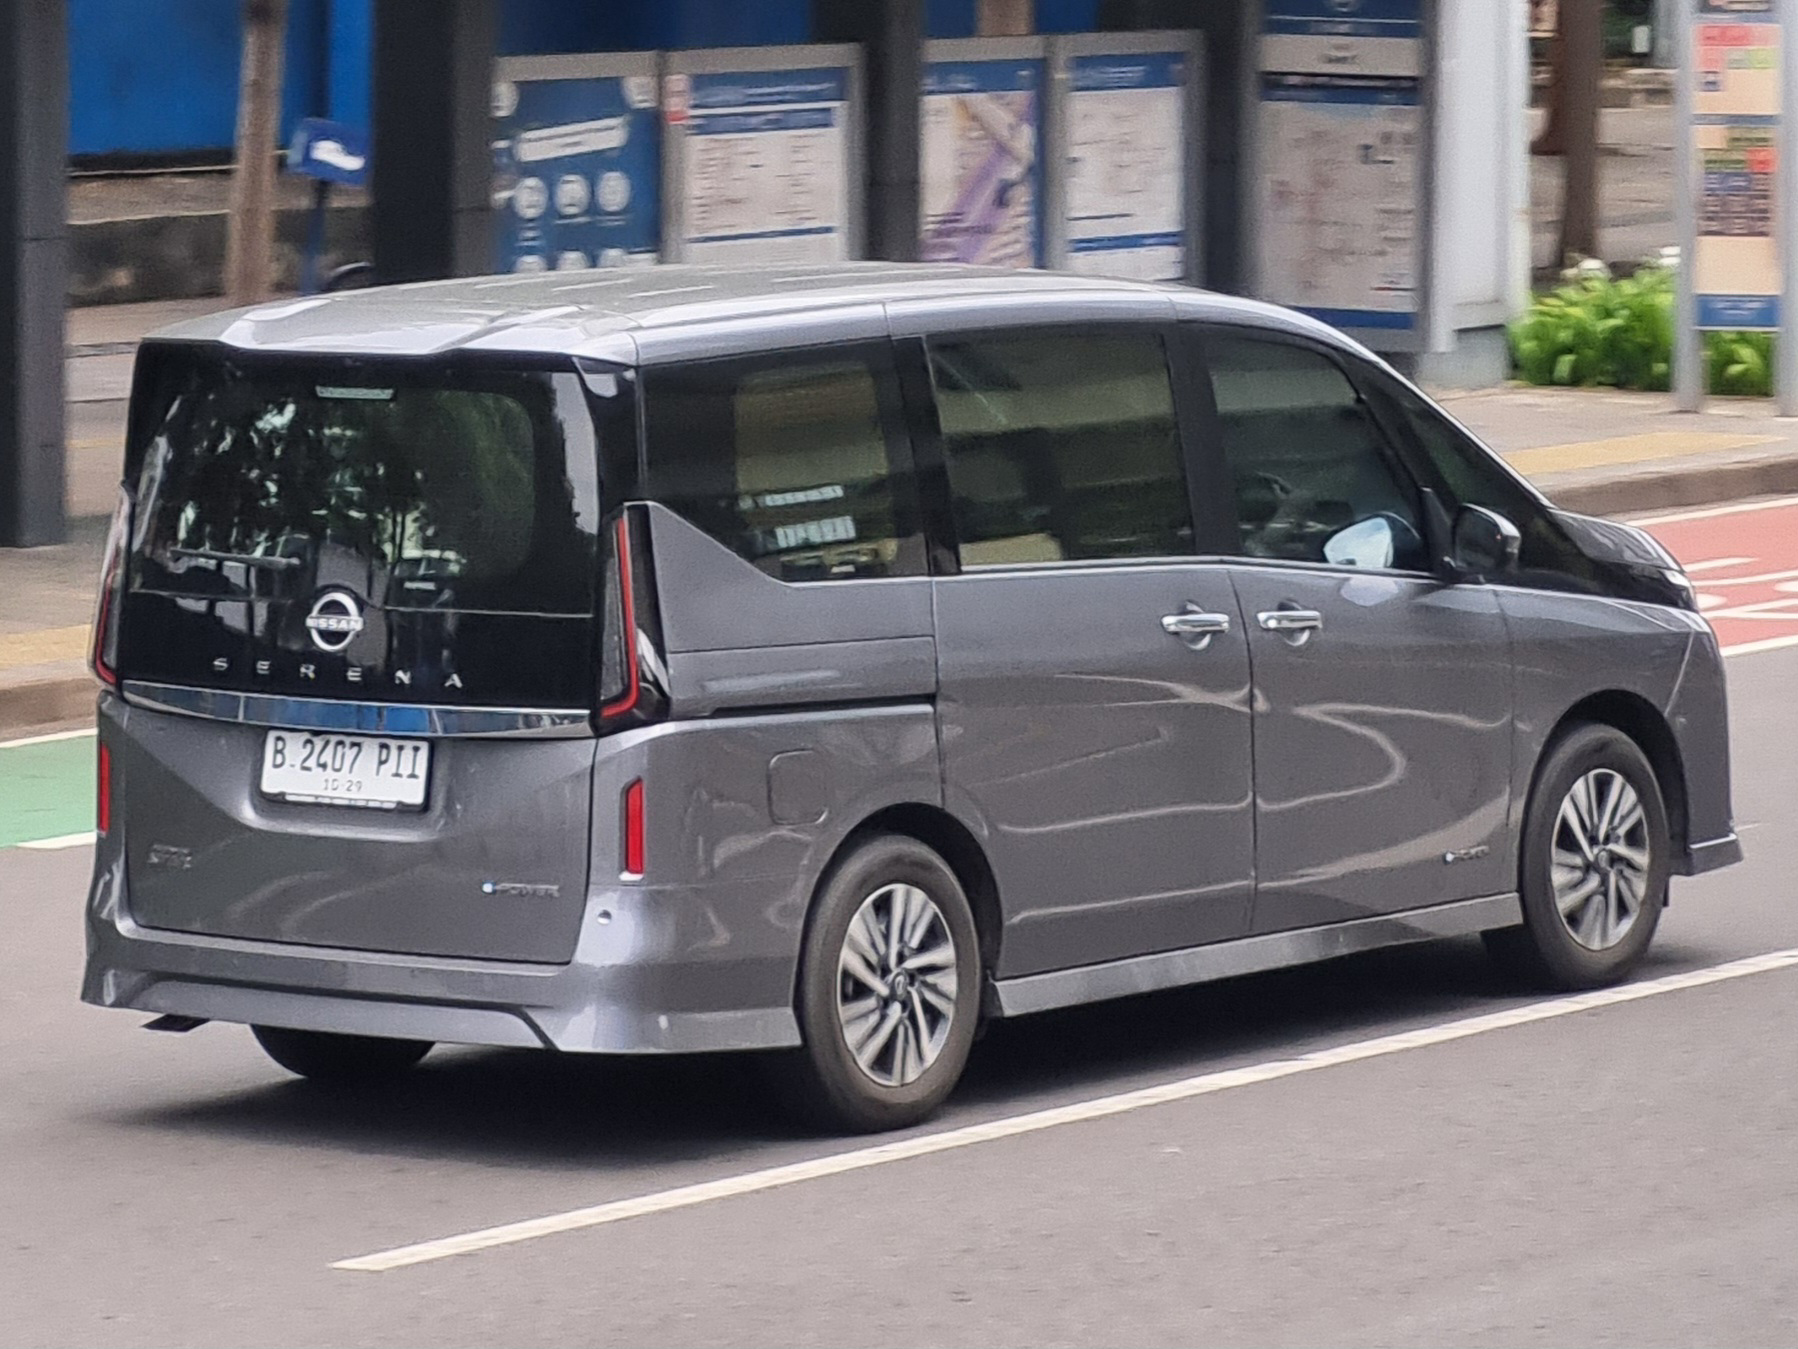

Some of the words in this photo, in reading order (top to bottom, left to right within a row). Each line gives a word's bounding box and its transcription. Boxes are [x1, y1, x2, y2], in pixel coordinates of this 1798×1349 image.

[213, 657, 463, 689] SERENA
[272, 735, 286, 769] B
[300, 737, 363, 774] 2407
[376, 742, 421, 779] PII
